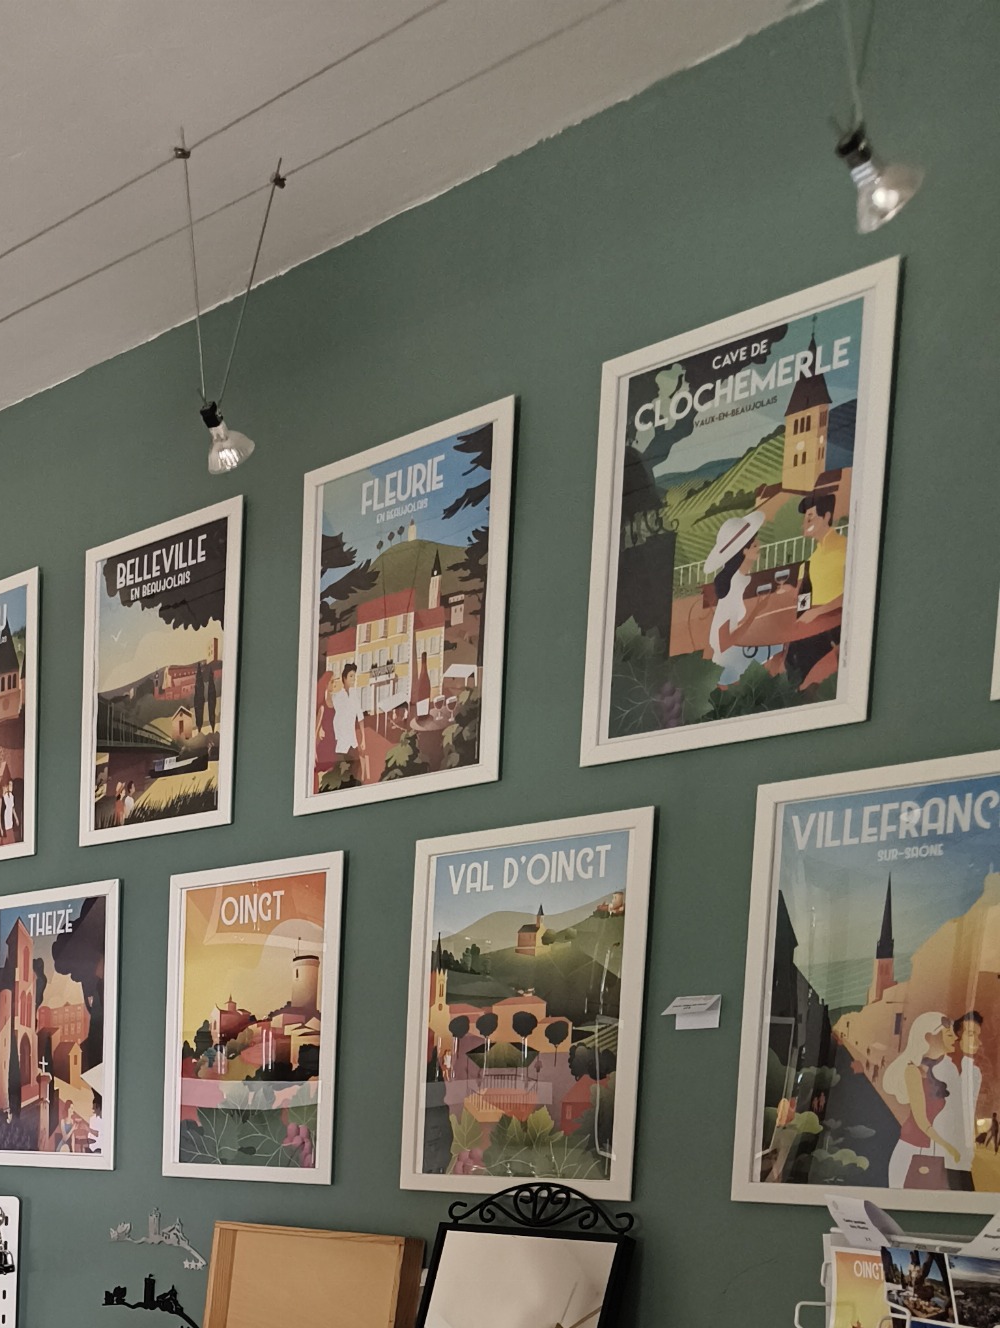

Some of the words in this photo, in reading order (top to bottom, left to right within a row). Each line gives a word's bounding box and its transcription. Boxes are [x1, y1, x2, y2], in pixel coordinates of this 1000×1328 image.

[712, 345, 747, 370] CAVE
[751, 339, 768, 357] DE
[634, 336, 851, 432] CLOCHEMERLE
[695, 395, 778, 429] VAUX-EN-BEAUJOLAIS
[361, 454, 445, 515] FLEURIE
[386, 498, 428, 521] BEAUJOLAIS
[116, 533, 207, 590] BELLEVILLE
[130, 586, 140, 601] EN
[142, 570, 191, 597] BEAUJOLAIS
[791, 790, 1000, 850] VILLEFRANC
[448, 860, 494, 895] VAL
[503, 844, 612, 889] D'OINGT
[28, 904, 73, 937] THEIZÉ
[221, 891, 285, 927] OINGT
